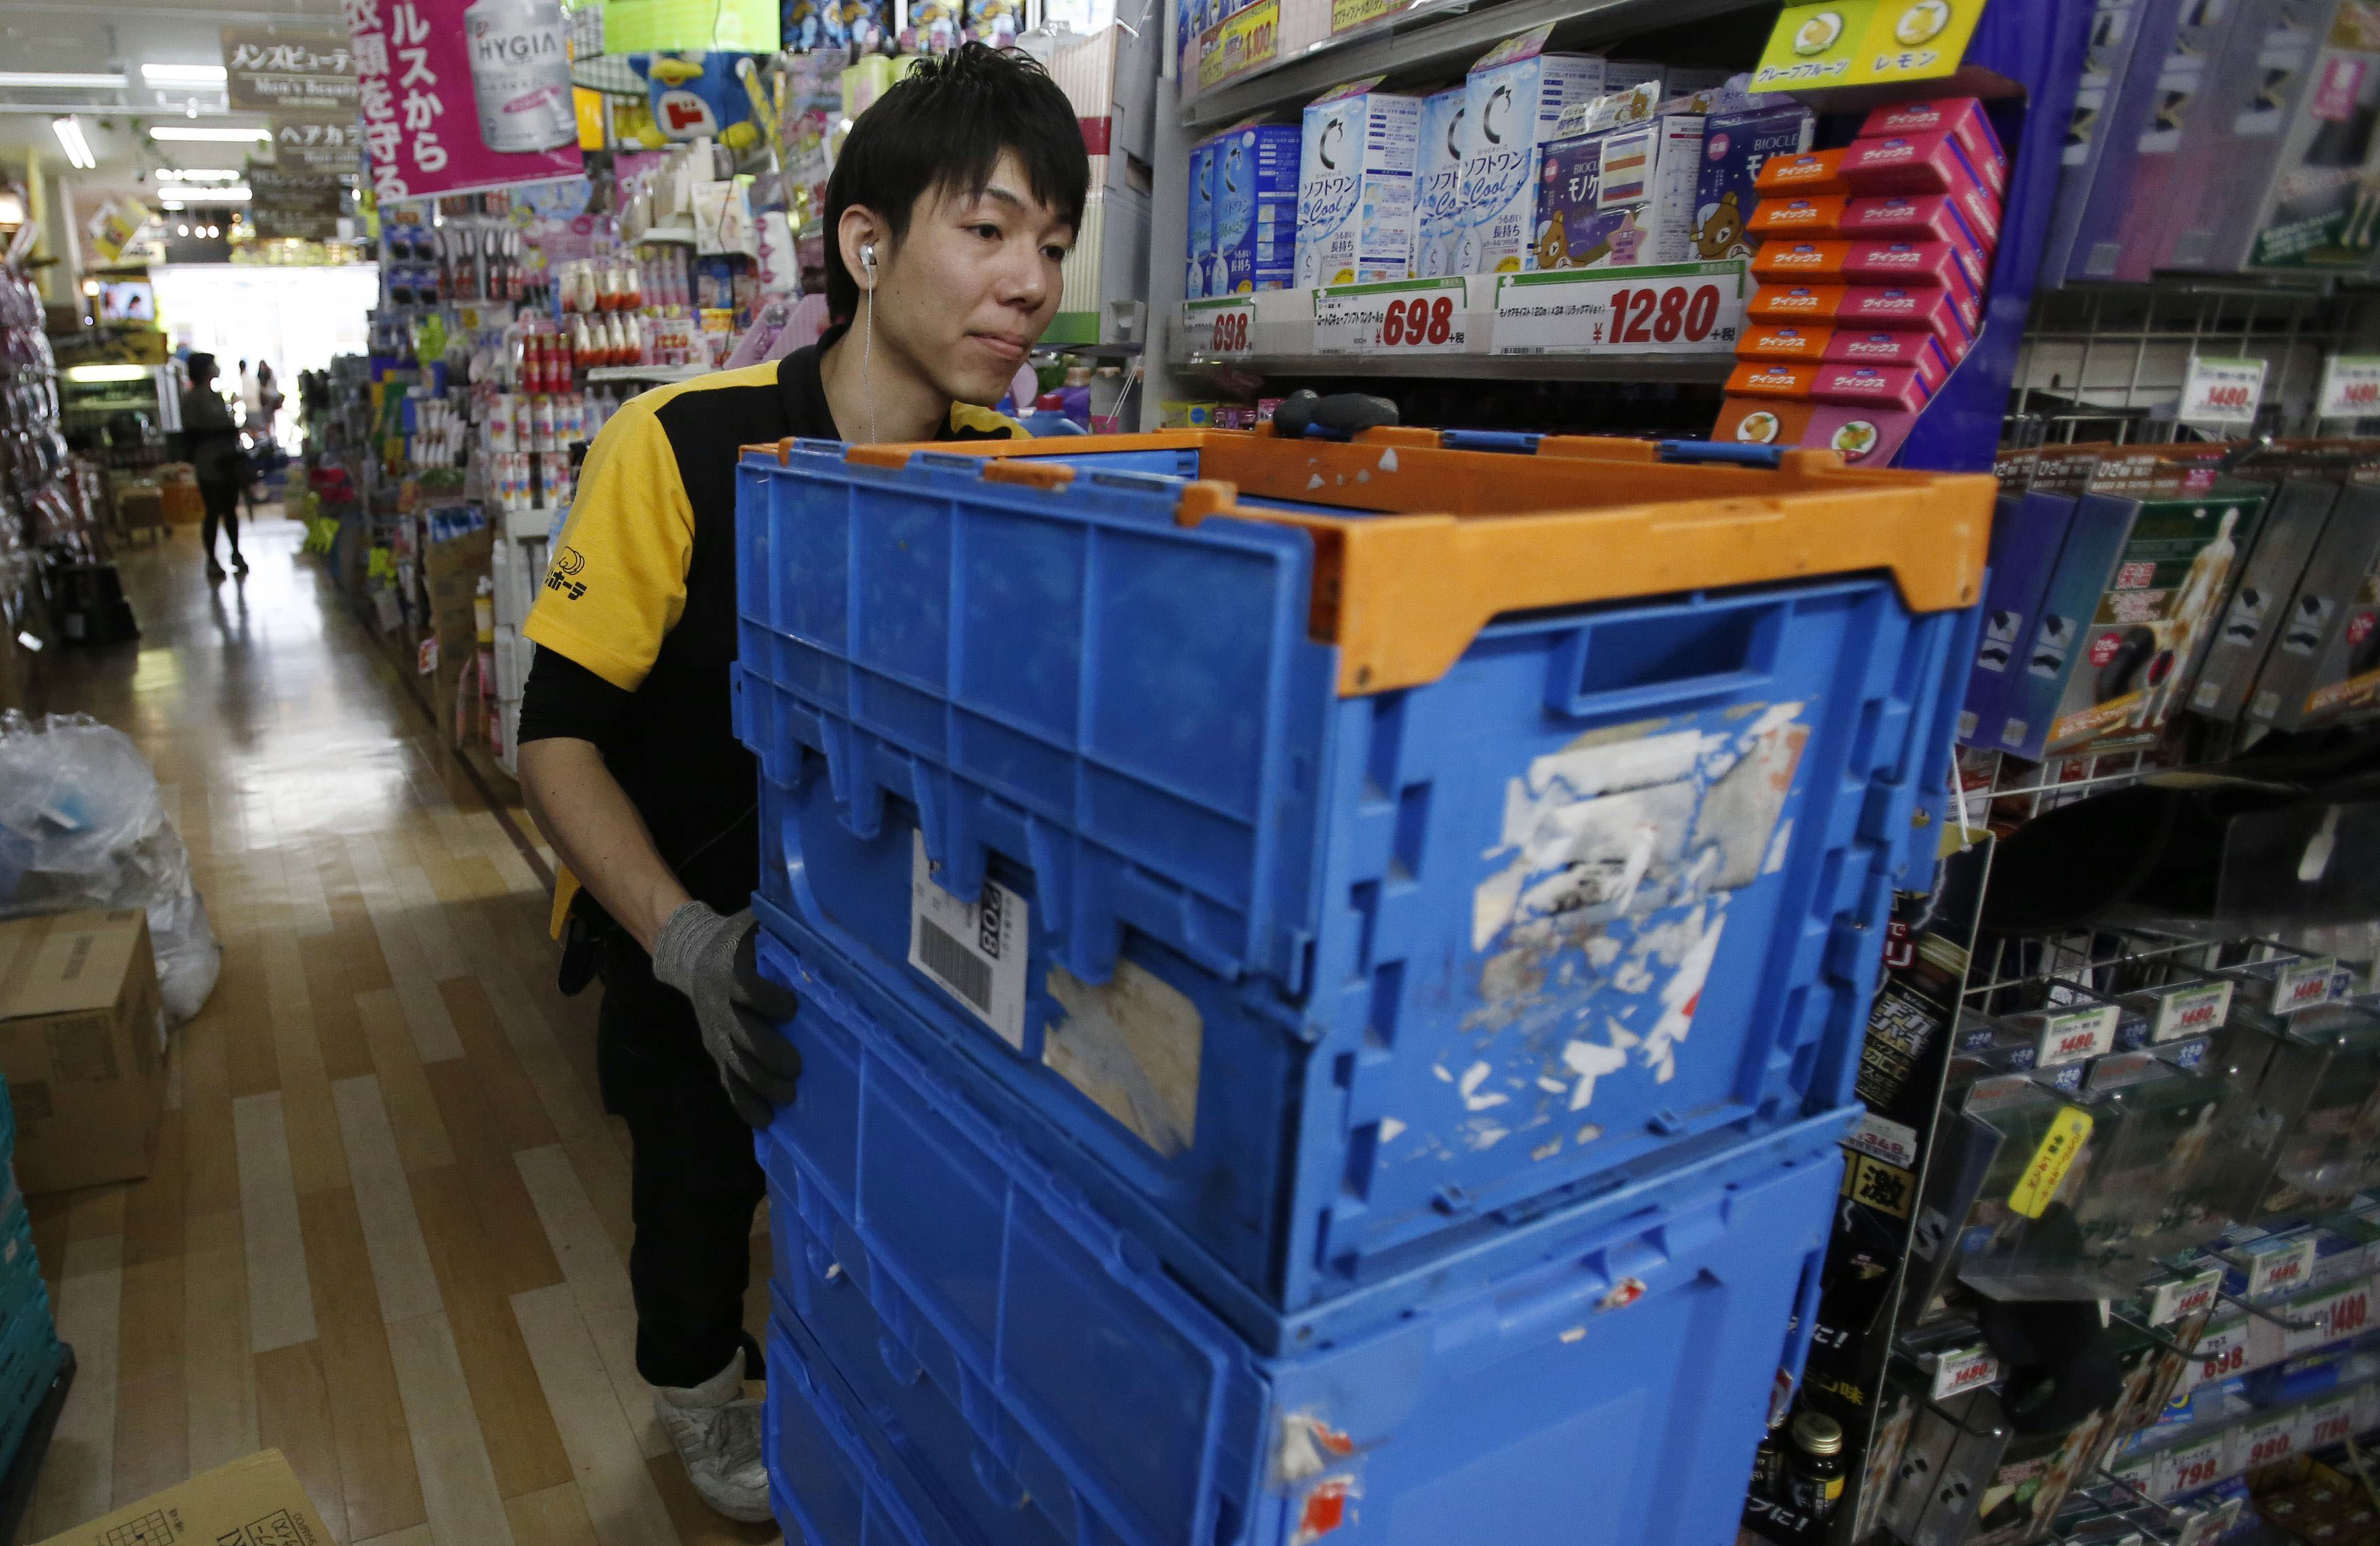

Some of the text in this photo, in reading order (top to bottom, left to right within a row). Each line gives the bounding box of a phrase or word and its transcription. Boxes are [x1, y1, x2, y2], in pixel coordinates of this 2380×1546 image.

[1875, 54, 1937, 71] レモン
[391, 3, 447, 171] ルスから
[1464, 151, 1525, 177] ソフトワン
[1304, 175, 1356, 200] ソフトワン
[1470, 174, 1508, 203] Cool
[1310, 195, 1342, 222] Cool
[1498, 214, 1522, 224] うるおい
[1493, 224, 1520, 239] 長持ち
[1331, 239, 1354, 254] 長持ち
[1383, 296, 1453, 346] 698
[1609, 284, 1720, 344] 1280
[1213, 313, 1248, 351] 698
[2181, 1006, 2214, 1026] 1480
[2060, 1031, 2094, 1053] 1480
[1955, 1362, 1988, 1384] 1480
[2203, 1345, 2243, 1379] 698
[2176, 1458, 2216, 1489] 798
